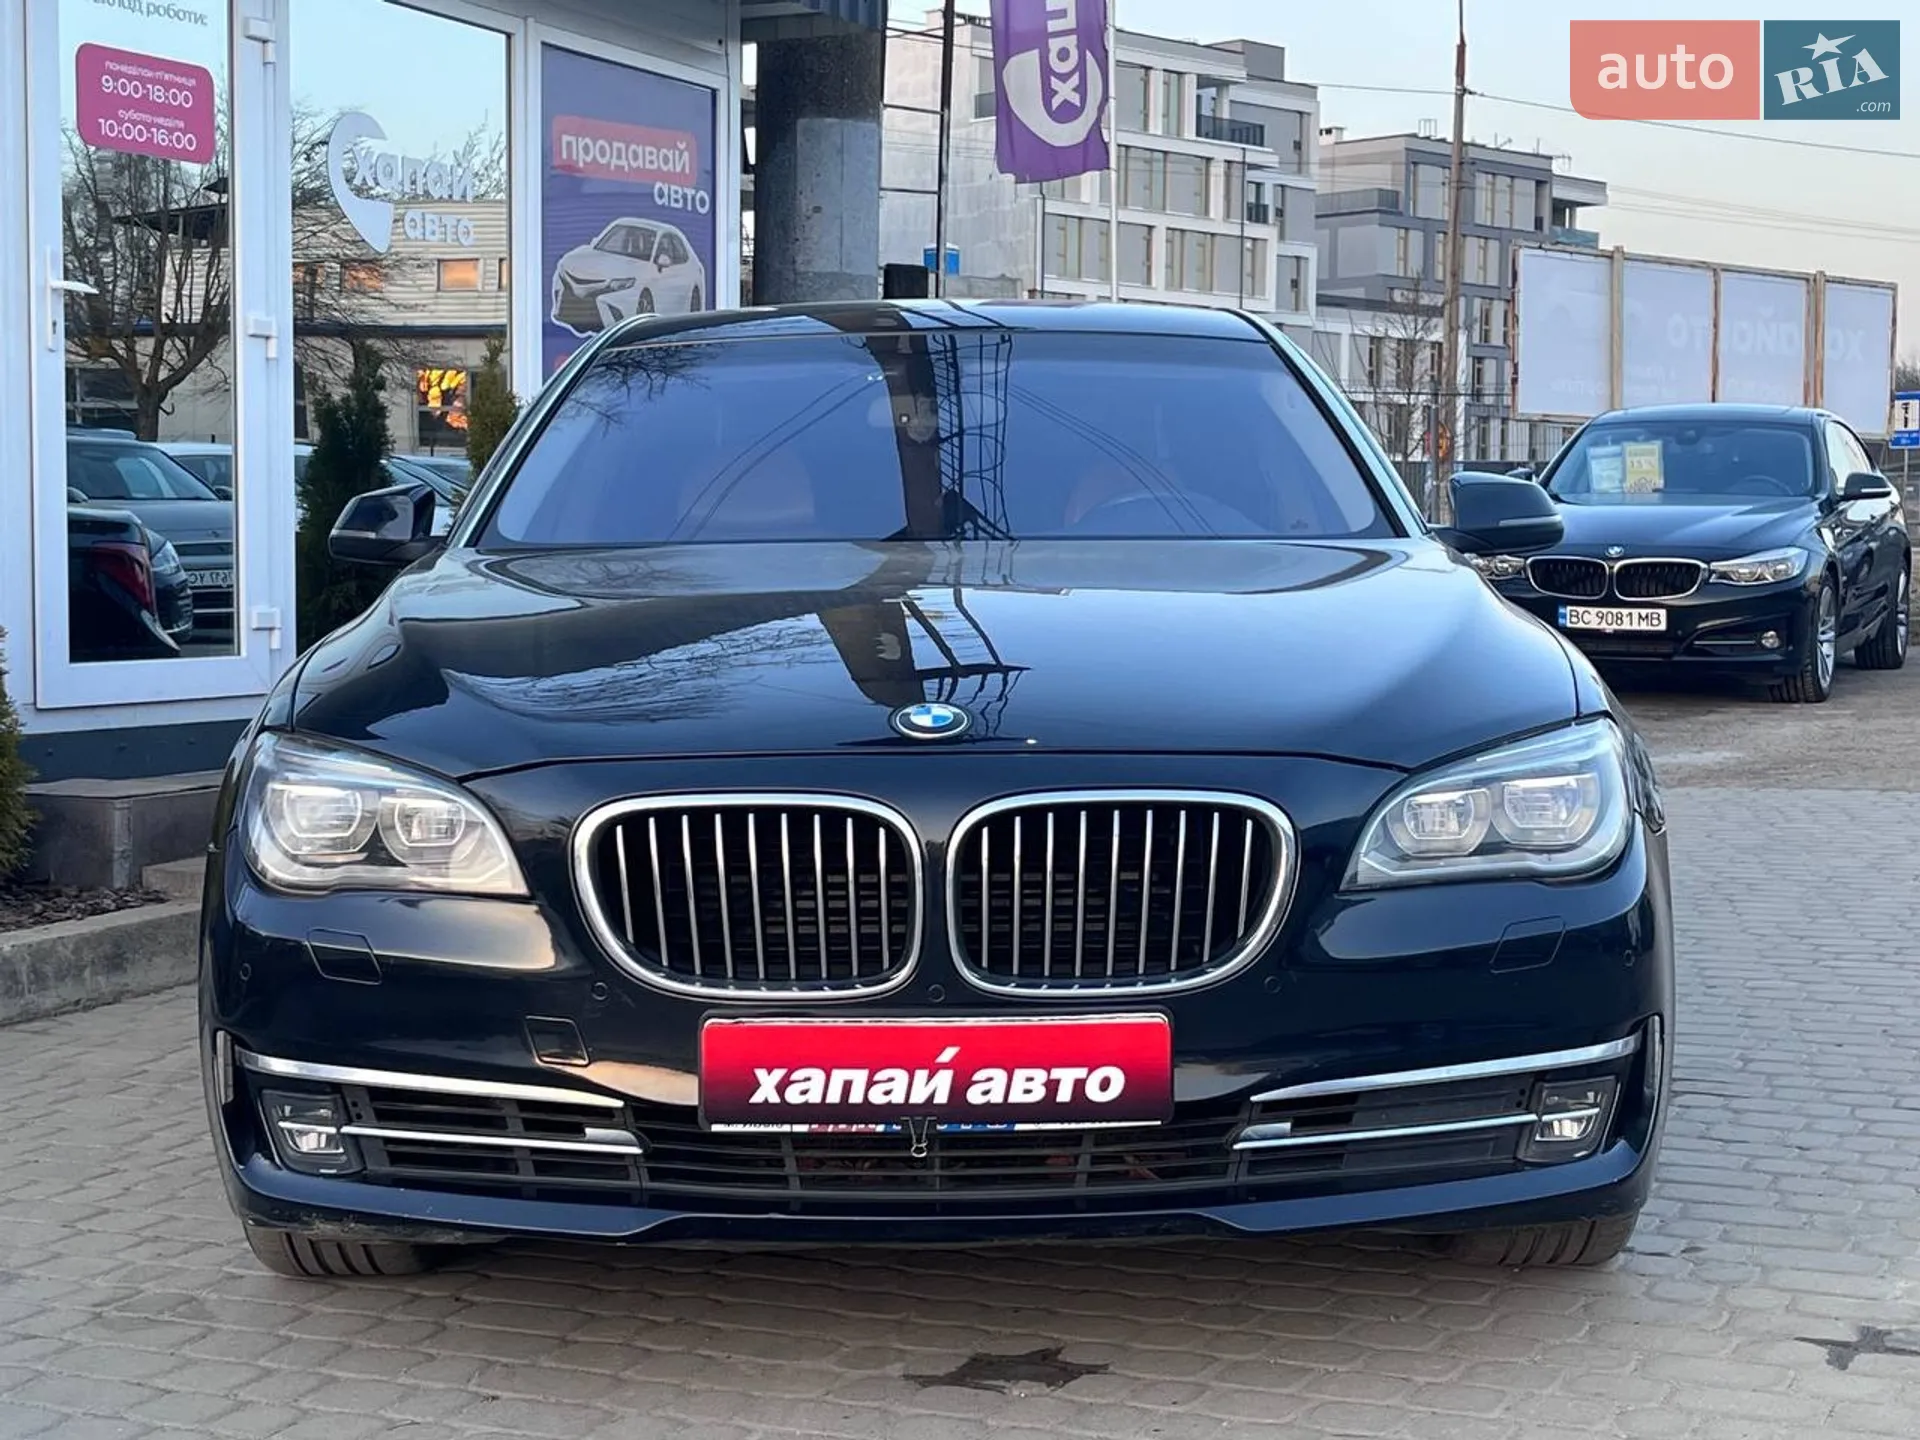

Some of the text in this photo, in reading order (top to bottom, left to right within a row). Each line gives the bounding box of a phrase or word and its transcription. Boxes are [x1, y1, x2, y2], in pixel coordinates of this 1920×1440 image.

[146, 2, 208, 26] роботи:
[101, 75, 193, 108] 9:00-18:00
[98, 118, 196, 151] 10:00-16:00
[561, 133, 690, 174] продавай
[653, 180, 711, 214] авто
[403, 209, 475, 247] авто
[1568, 609, 1662, 627] BC 9081 MB
[965, 1066, 1126, 1104] авто
